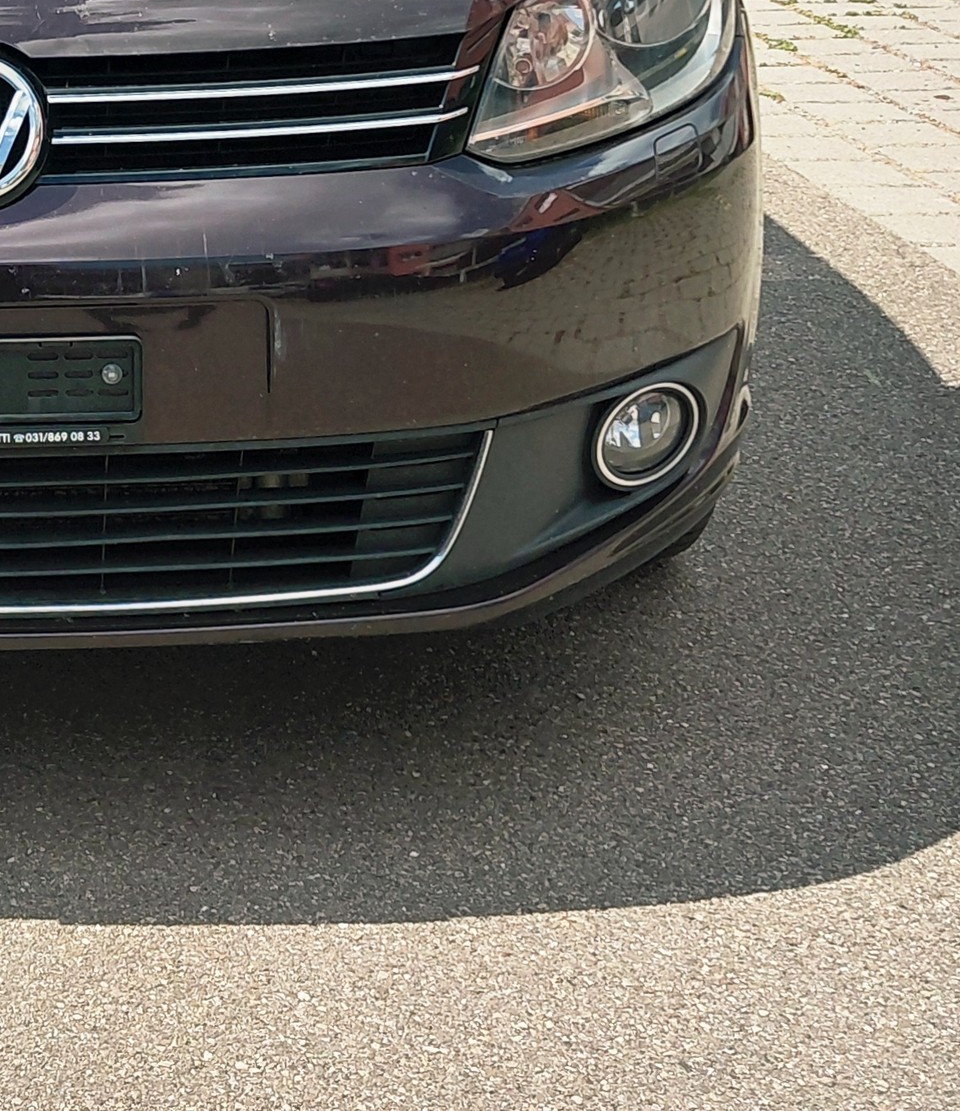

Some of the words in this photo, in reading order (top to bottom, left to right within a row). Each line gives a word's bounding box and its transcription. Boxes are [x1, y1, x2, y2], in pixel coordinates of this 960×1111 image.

[25, 431, 68, 442] 031/869
[70, 431, 85, 442] 08
[86, 430, 101, 441] 33
